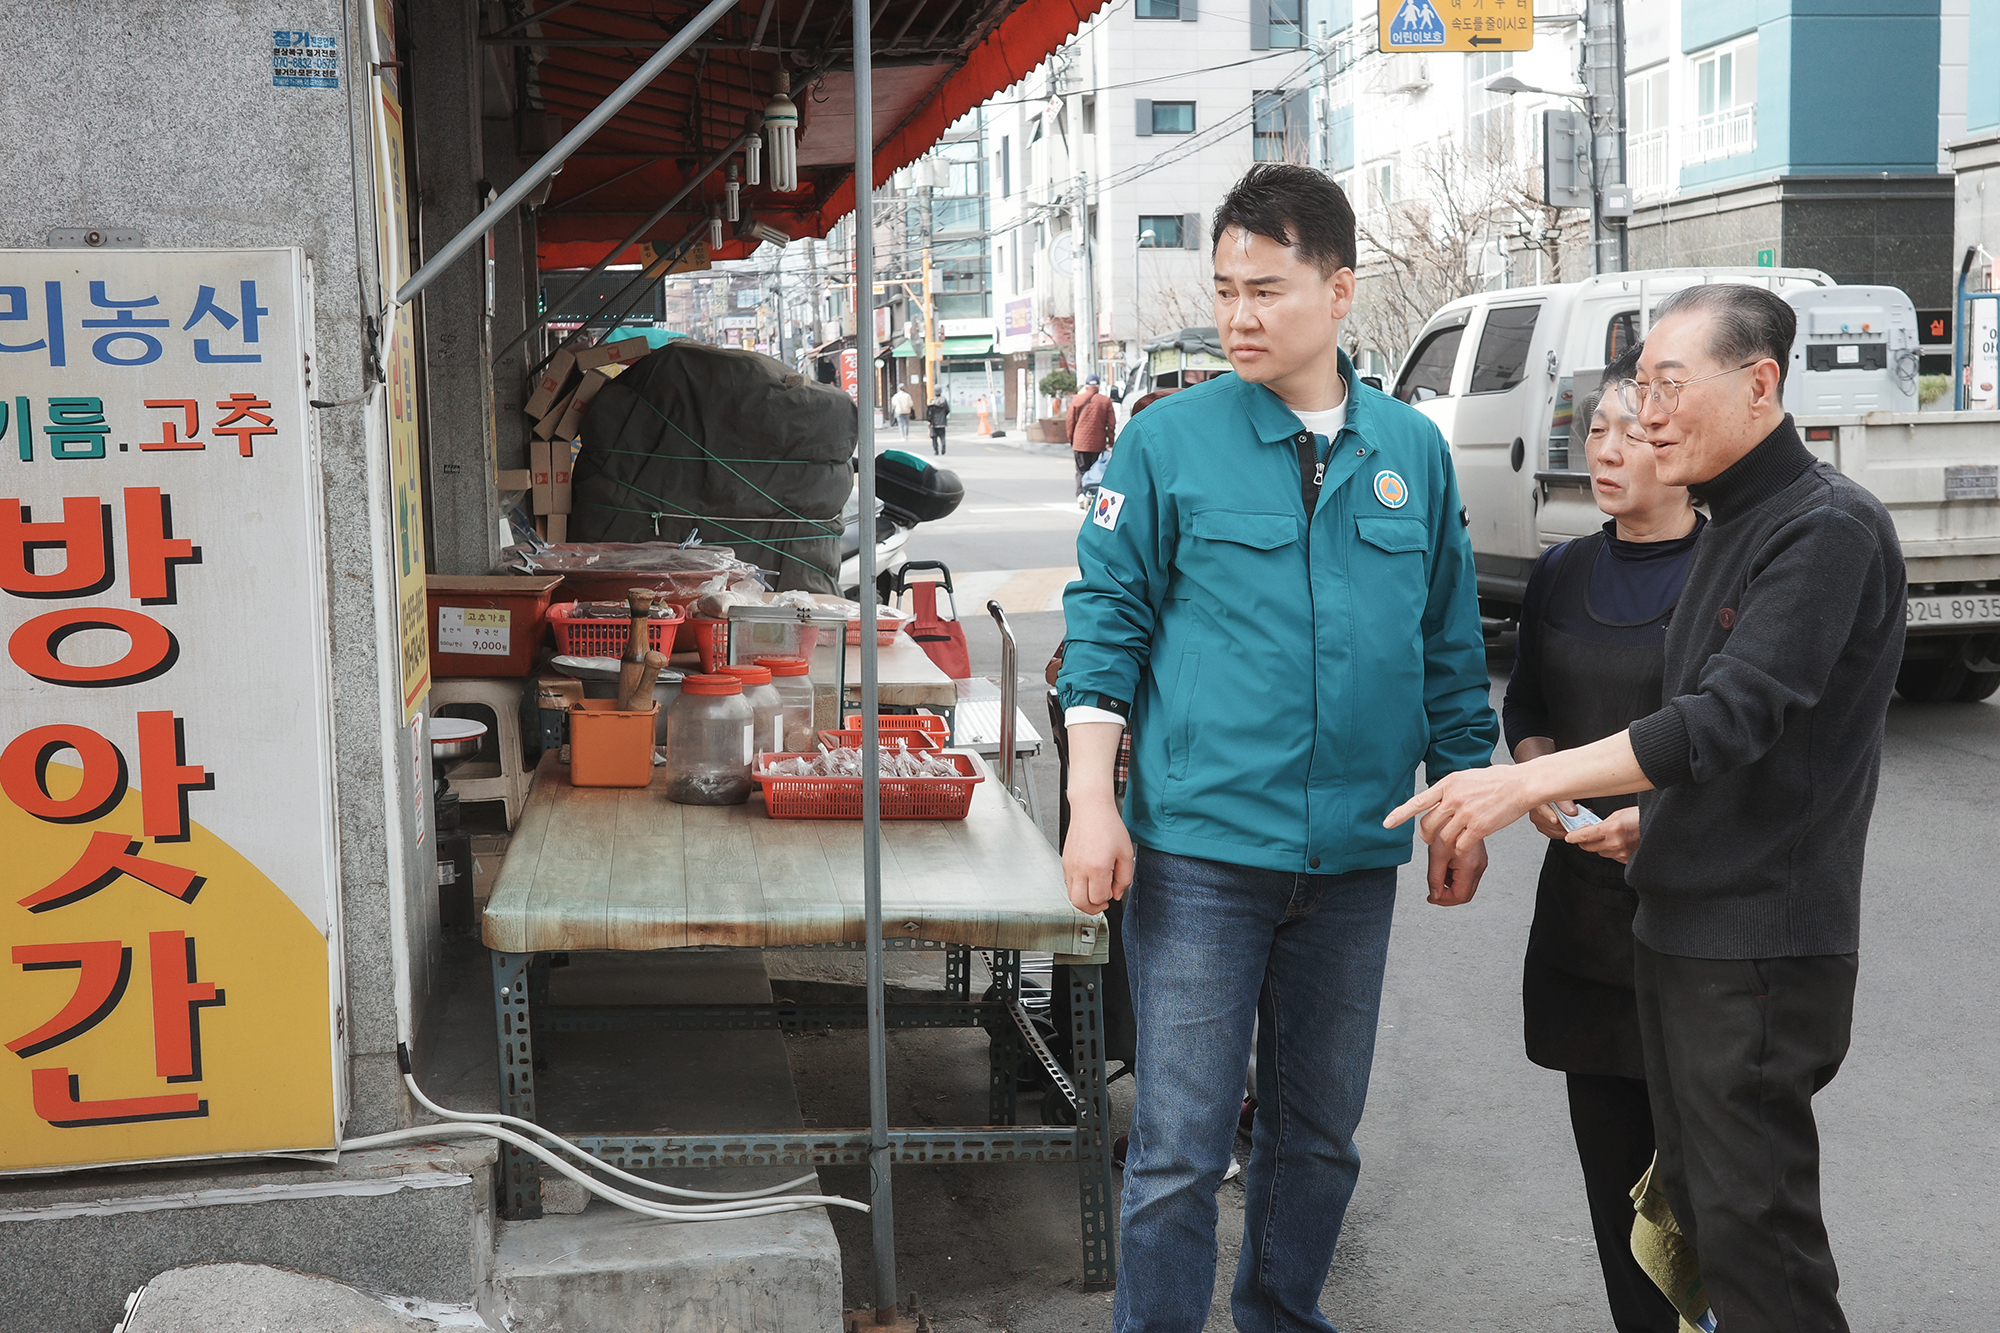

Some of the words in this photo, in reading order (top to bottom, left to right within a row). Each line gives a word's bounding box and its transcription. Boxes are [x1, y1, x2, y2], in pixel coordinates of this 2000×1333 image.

[1452, 17, 1483, 31] 속도를
[1485, 17, 1528, 31] 줄이시오
[1392, 31, 1442, 43] 어린이보호
[0, 280, 269, 367] 리농산
[468, 613, 506, 622] 고추가루
[1951, 599, 2000, 619] 8935
[0, 487, 226, 1129] 방앗간
